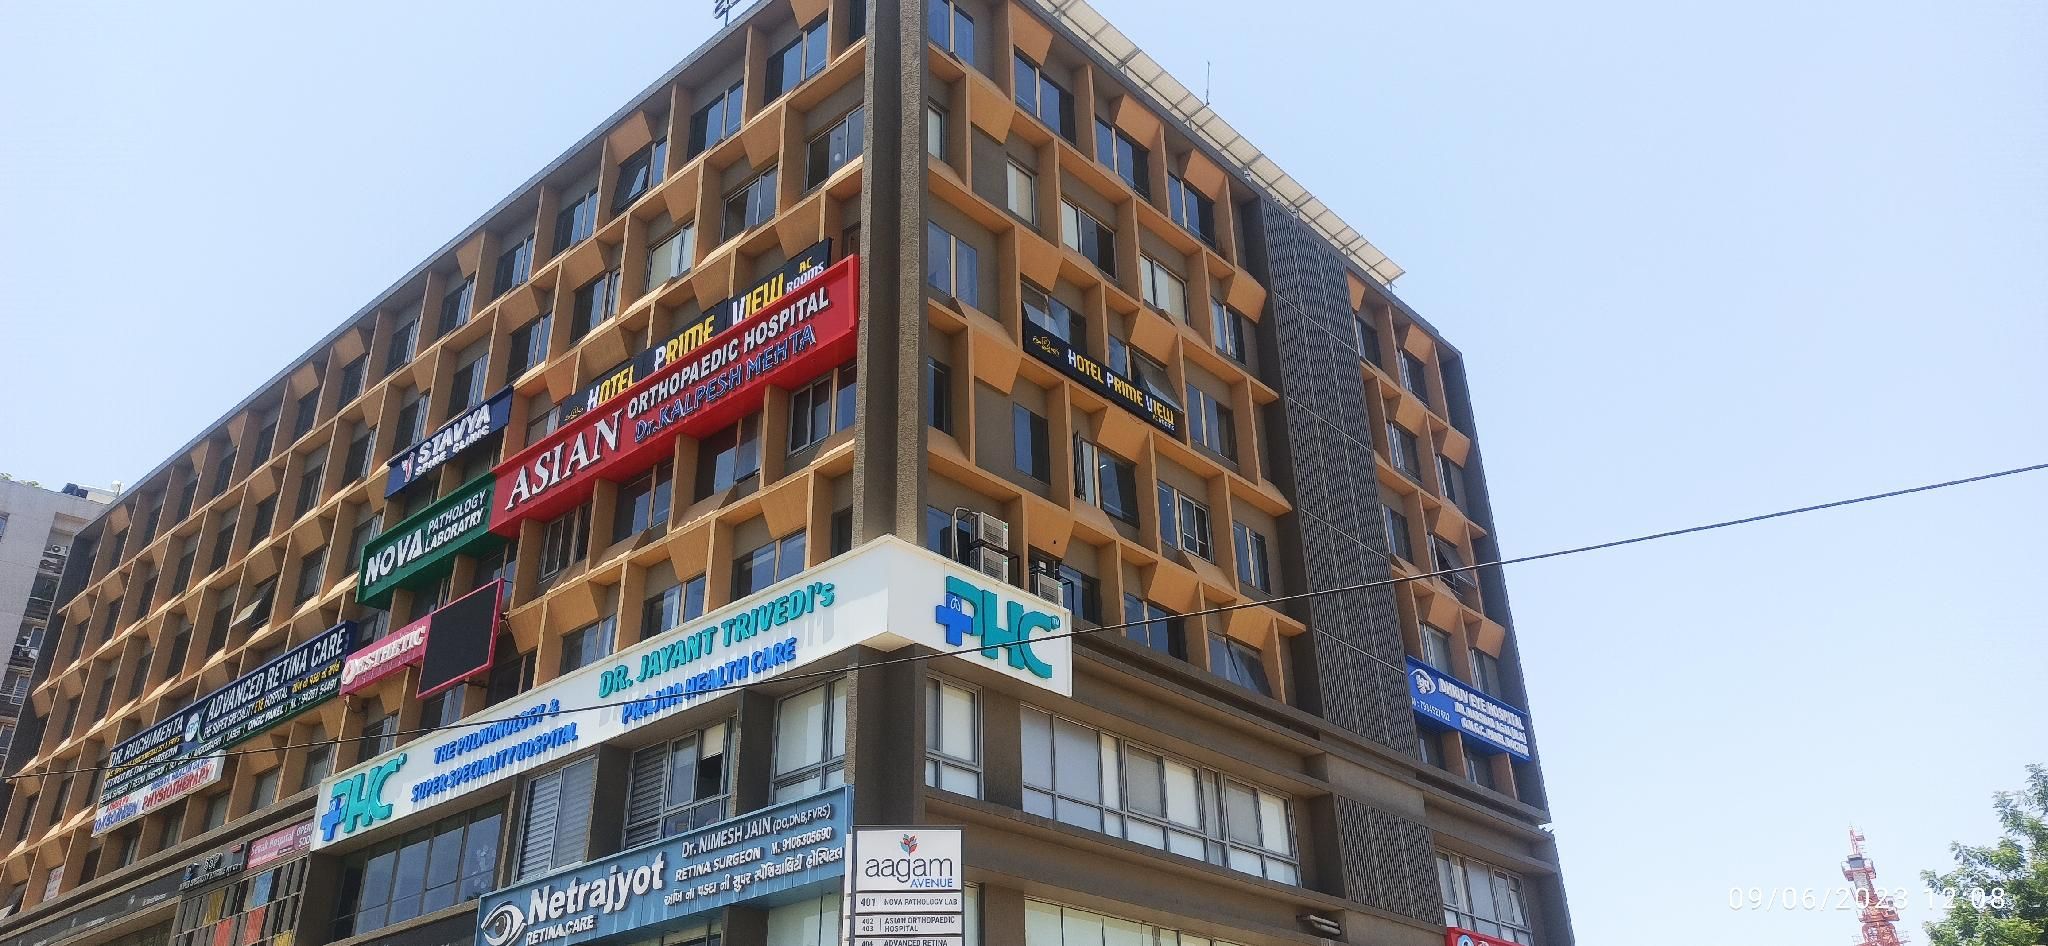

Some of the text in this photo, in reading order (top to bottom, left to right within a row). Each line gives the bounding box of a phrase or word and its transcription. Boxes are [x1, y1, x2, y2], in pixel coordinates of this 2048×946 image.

[586, 261, 825, 412] HOTEL PRIME VIEW ROOMS
[627, 286, 830, 419] ORTHOPAEDIC HOSPITAL
[746, 324, 817, 380] MEHTA
[1067, 348, 1175, 425] HOTEL PRIME VIEW
[418, 404, 491, 464] STAVYA
[505, 408, 625, 513] ASIAN
[427, 488, 487, 536] PATHOLOGY
[364, 507, 484, 586] NOVA LABORATRY
[599, 581, 836, 699] DR. JAYANT TRIVEDI's
[944, 576, 1052, 679] PHC
[206, 673, 265, 723] ADVANCED
[265, 649, 307, 691] RETINA
[310, 627, 346, 668] CARE
[684, 657, 749, 701] HEALTH
[750, 636, 798, 674] CARE
[411, 721, 579, 803] SUPER SPECIALITY HOSPITAL
[434, 741, 457, 765] THE
[457, 703, 547, 756] PULMONOLOGY
[674, 861, 713, 882] RETINA
[713, 846, 763, 871] SURGEON
[682, 841, 697, 859] Dr.
[699, 825, 743, 854] NIMESH
[744, 816, 772, 840] JAIN
[527, 850, 666, 926] Netrajyot
[865, 858, 953, 883] aagam
[910, 878, 953, 888] AVENUE
[526, 914, 597, 946] RETINA CARE
[860, 897, 958, 907] 401 NOVA PATHOLOGY LAB
[861, 915, 955, 925] 402 ASIAN ORTHOPAEDIC
[884, 924, 919, 933] HOSPITAL
